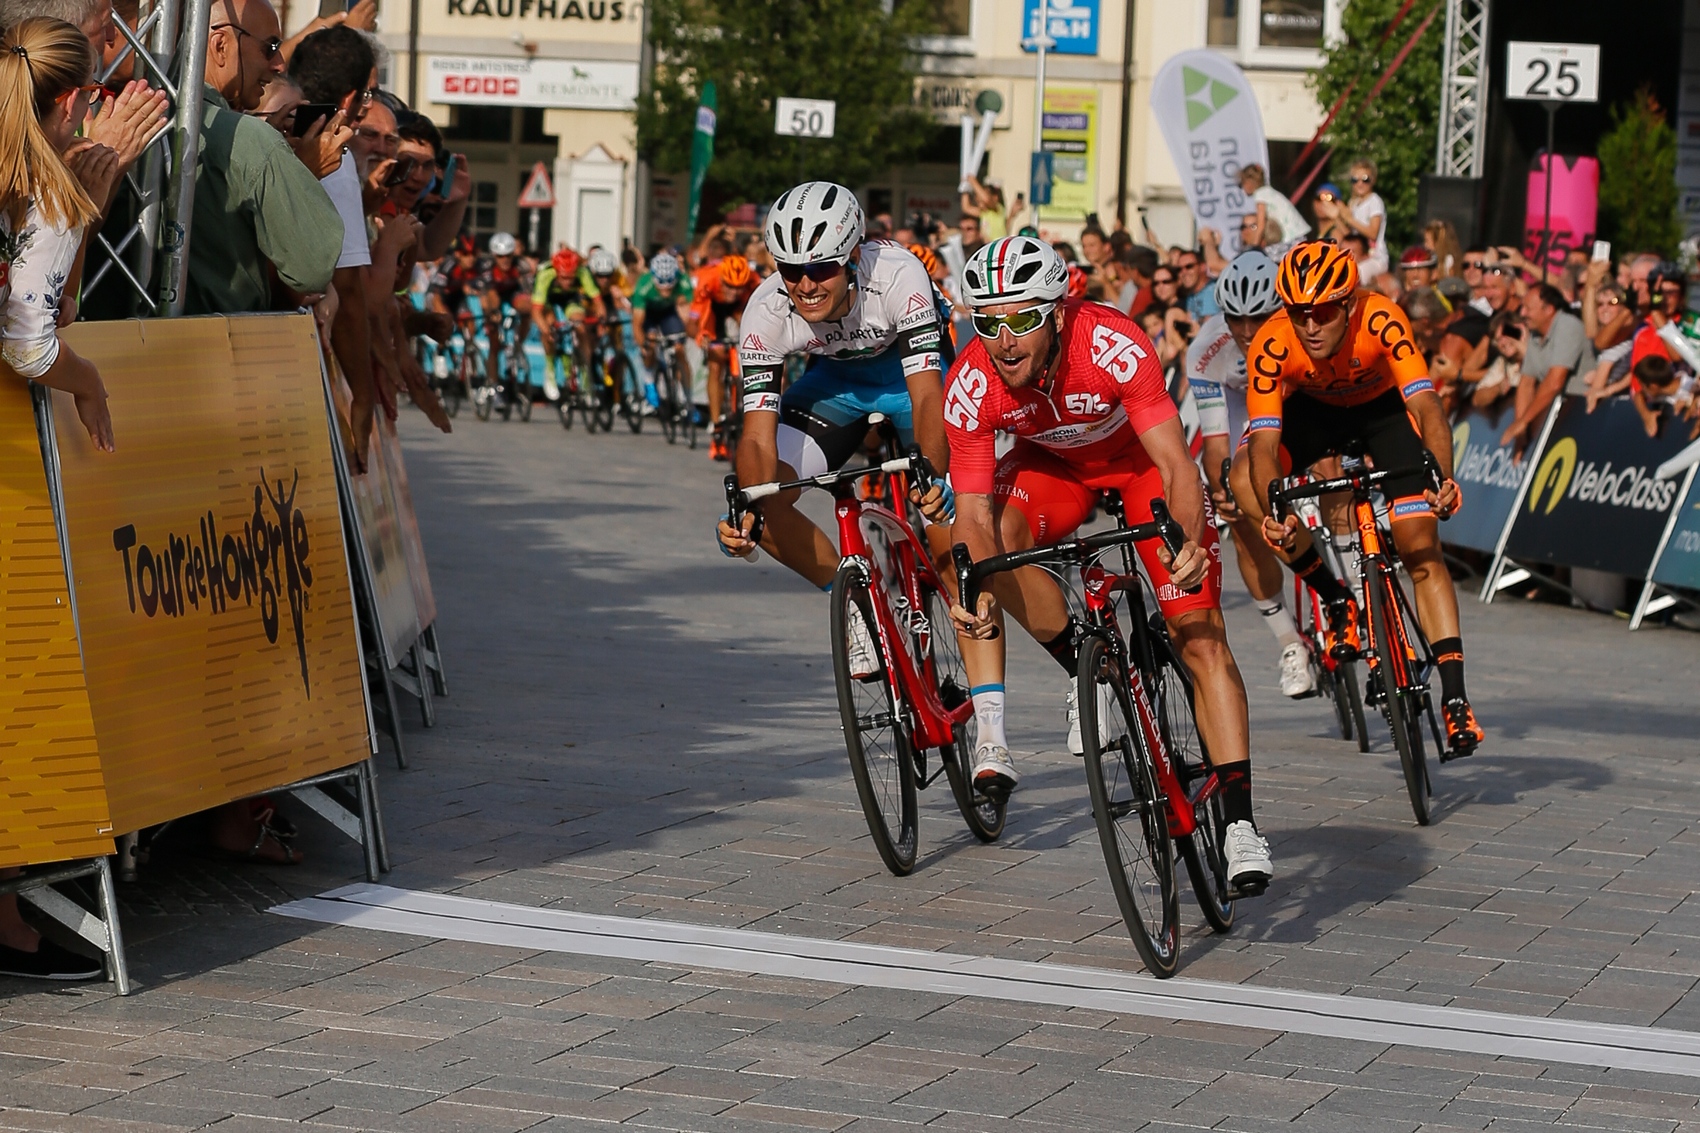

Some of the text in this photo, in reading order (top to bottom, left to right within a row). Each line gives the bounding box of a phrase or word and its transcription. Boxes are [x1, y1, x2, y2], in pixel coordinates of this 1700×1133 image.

[447, 0, 623, 21] KAUFHAUS
[1526, 59, 1581, 97] 25
[791, 109, 823, 137] 50
[834, 223, 857, 254] TREK
[1089, 323, 1149, 385] 575
[1367, 310, 1415, 362] CCC
[1252, 337, 1290, 395] CCC
[943, 361, 988, 432] 575
[1065, 392, 1112, 416] 575
[993, 483, 1030, 503] RETANA
[1568, 460, 1678, 512] VeloClass
